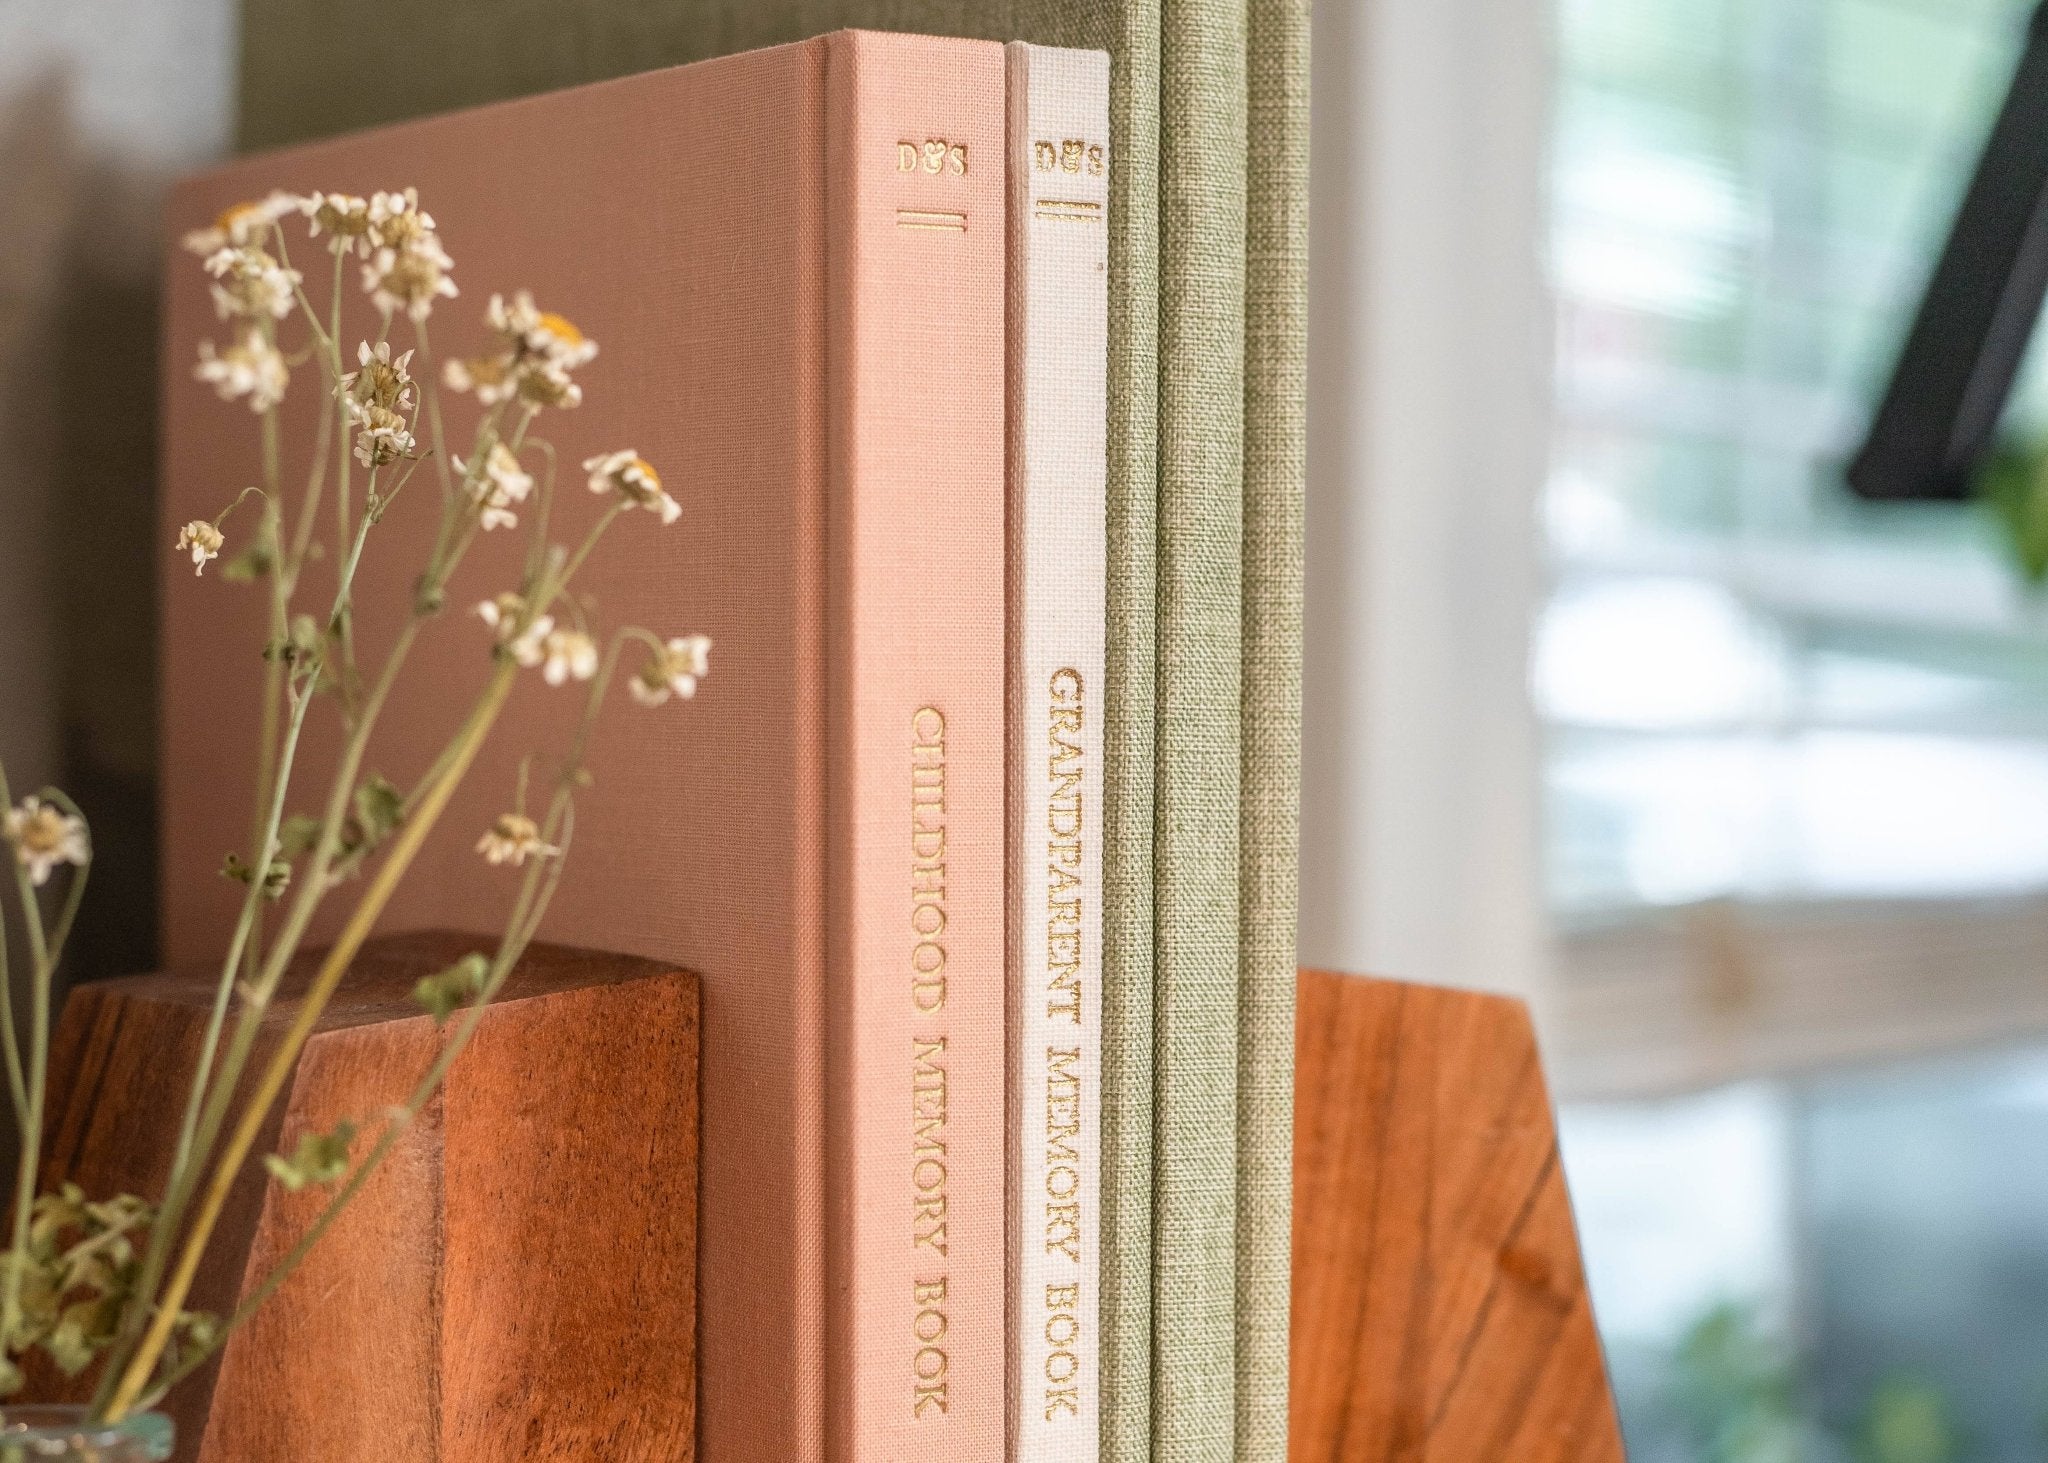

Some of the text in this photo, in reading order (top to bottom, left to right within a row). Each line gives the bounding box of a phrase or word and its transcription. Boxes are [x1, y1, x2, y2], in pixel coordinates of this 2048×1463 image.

[897, 140, 968, 176] D&S
[1035, 139, 1104, 176] D&S
[911, 706, 949, 1419] CHILDHOOD MEMORY BOOK
[1044, 667, 1085, 1422] GRANDPARENT MEMORY BOOK
